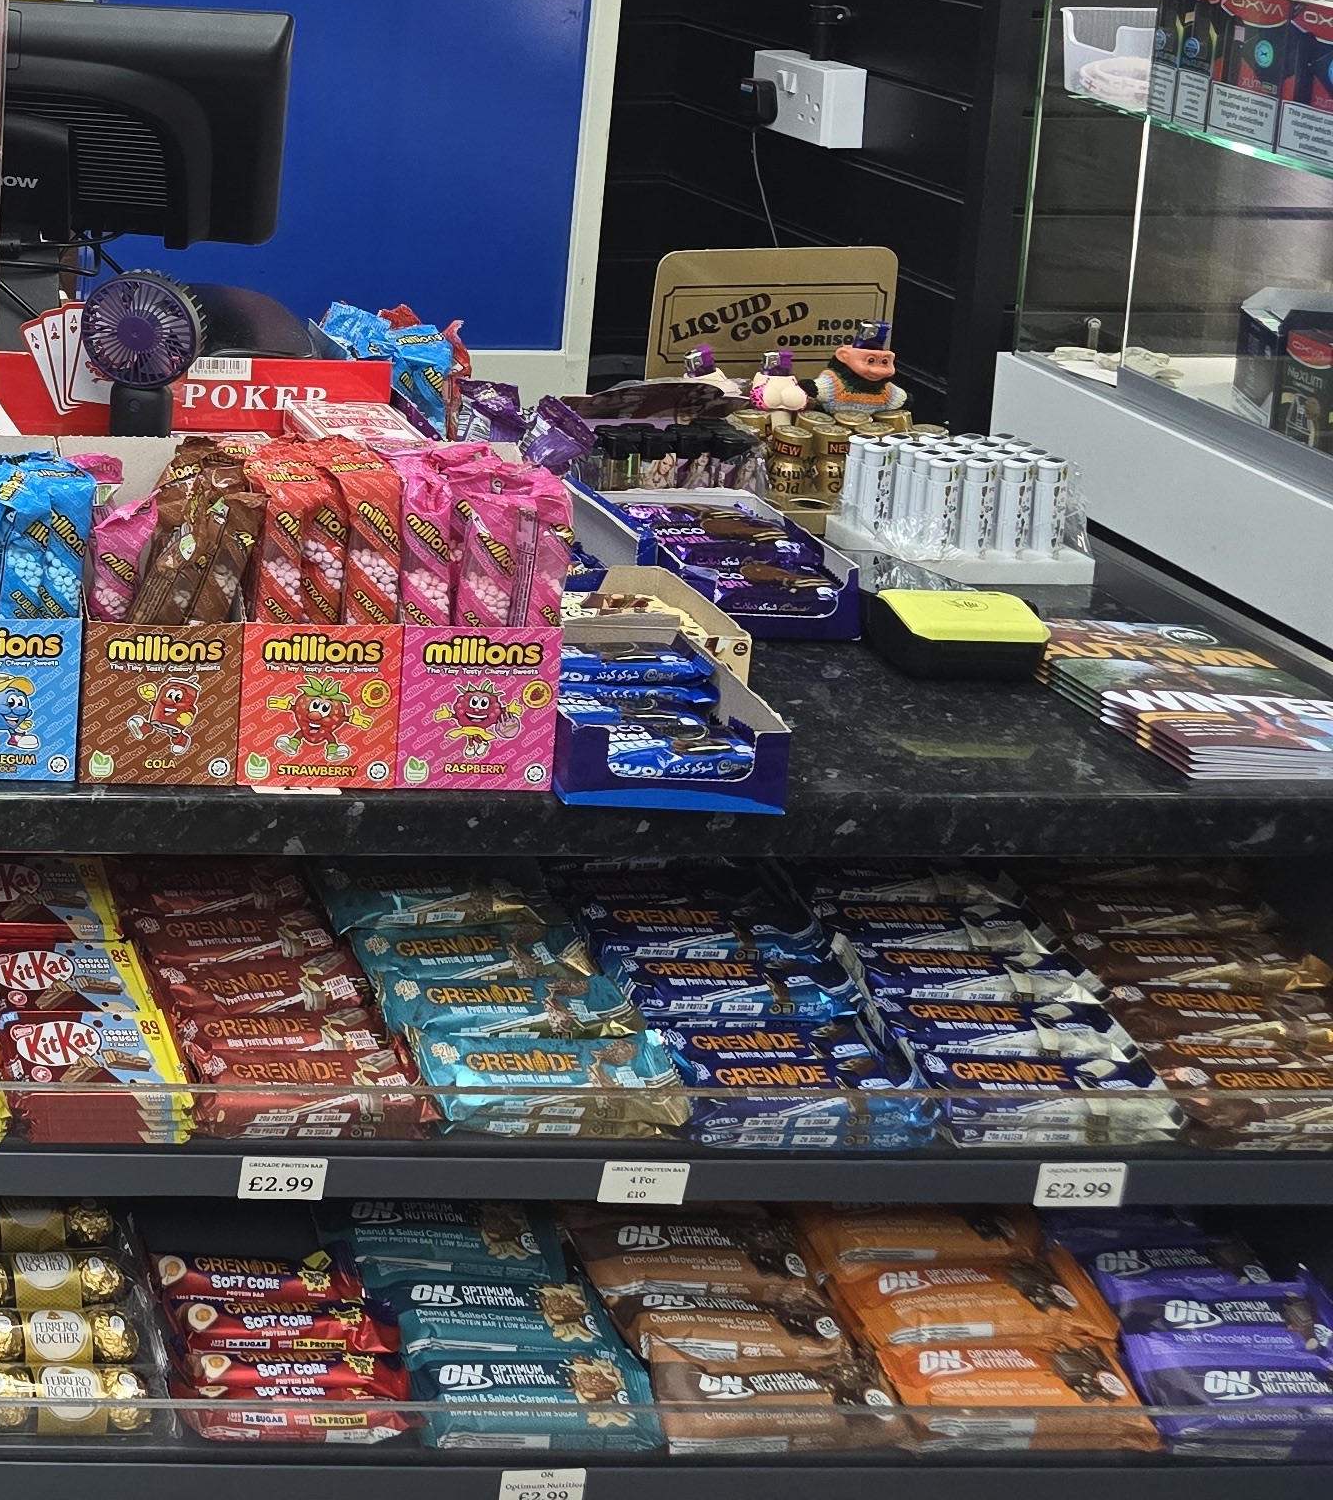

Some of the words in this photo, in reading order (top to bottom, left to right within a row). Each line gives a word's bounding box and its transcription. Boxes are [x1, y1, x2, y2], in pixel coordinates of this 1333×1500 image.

[669, 292, 771, 343] LIQUID
[731, 302, 809, 342] GOLD
[182, 384, 328, 411] POKER
[773, 441, 801, 456] NEW
[106, 635, 227, 665] millions
[264, 634, 382, 664] millions
[144, 758, 177, 770] COLA
[277, 765, 358, 777] STRAWBERRY
[444, 763, 506, 774] RASPBERRY
[248, 1176, 314, 1194] £2.99
[1045, 1181, 1111, 1199] £2.99
[461, 1285, 514, 1297] OPTIMUM
[34, 1322, 79, 1333] FERRERO
[36, 1332, 79, 1344] ROCHER
